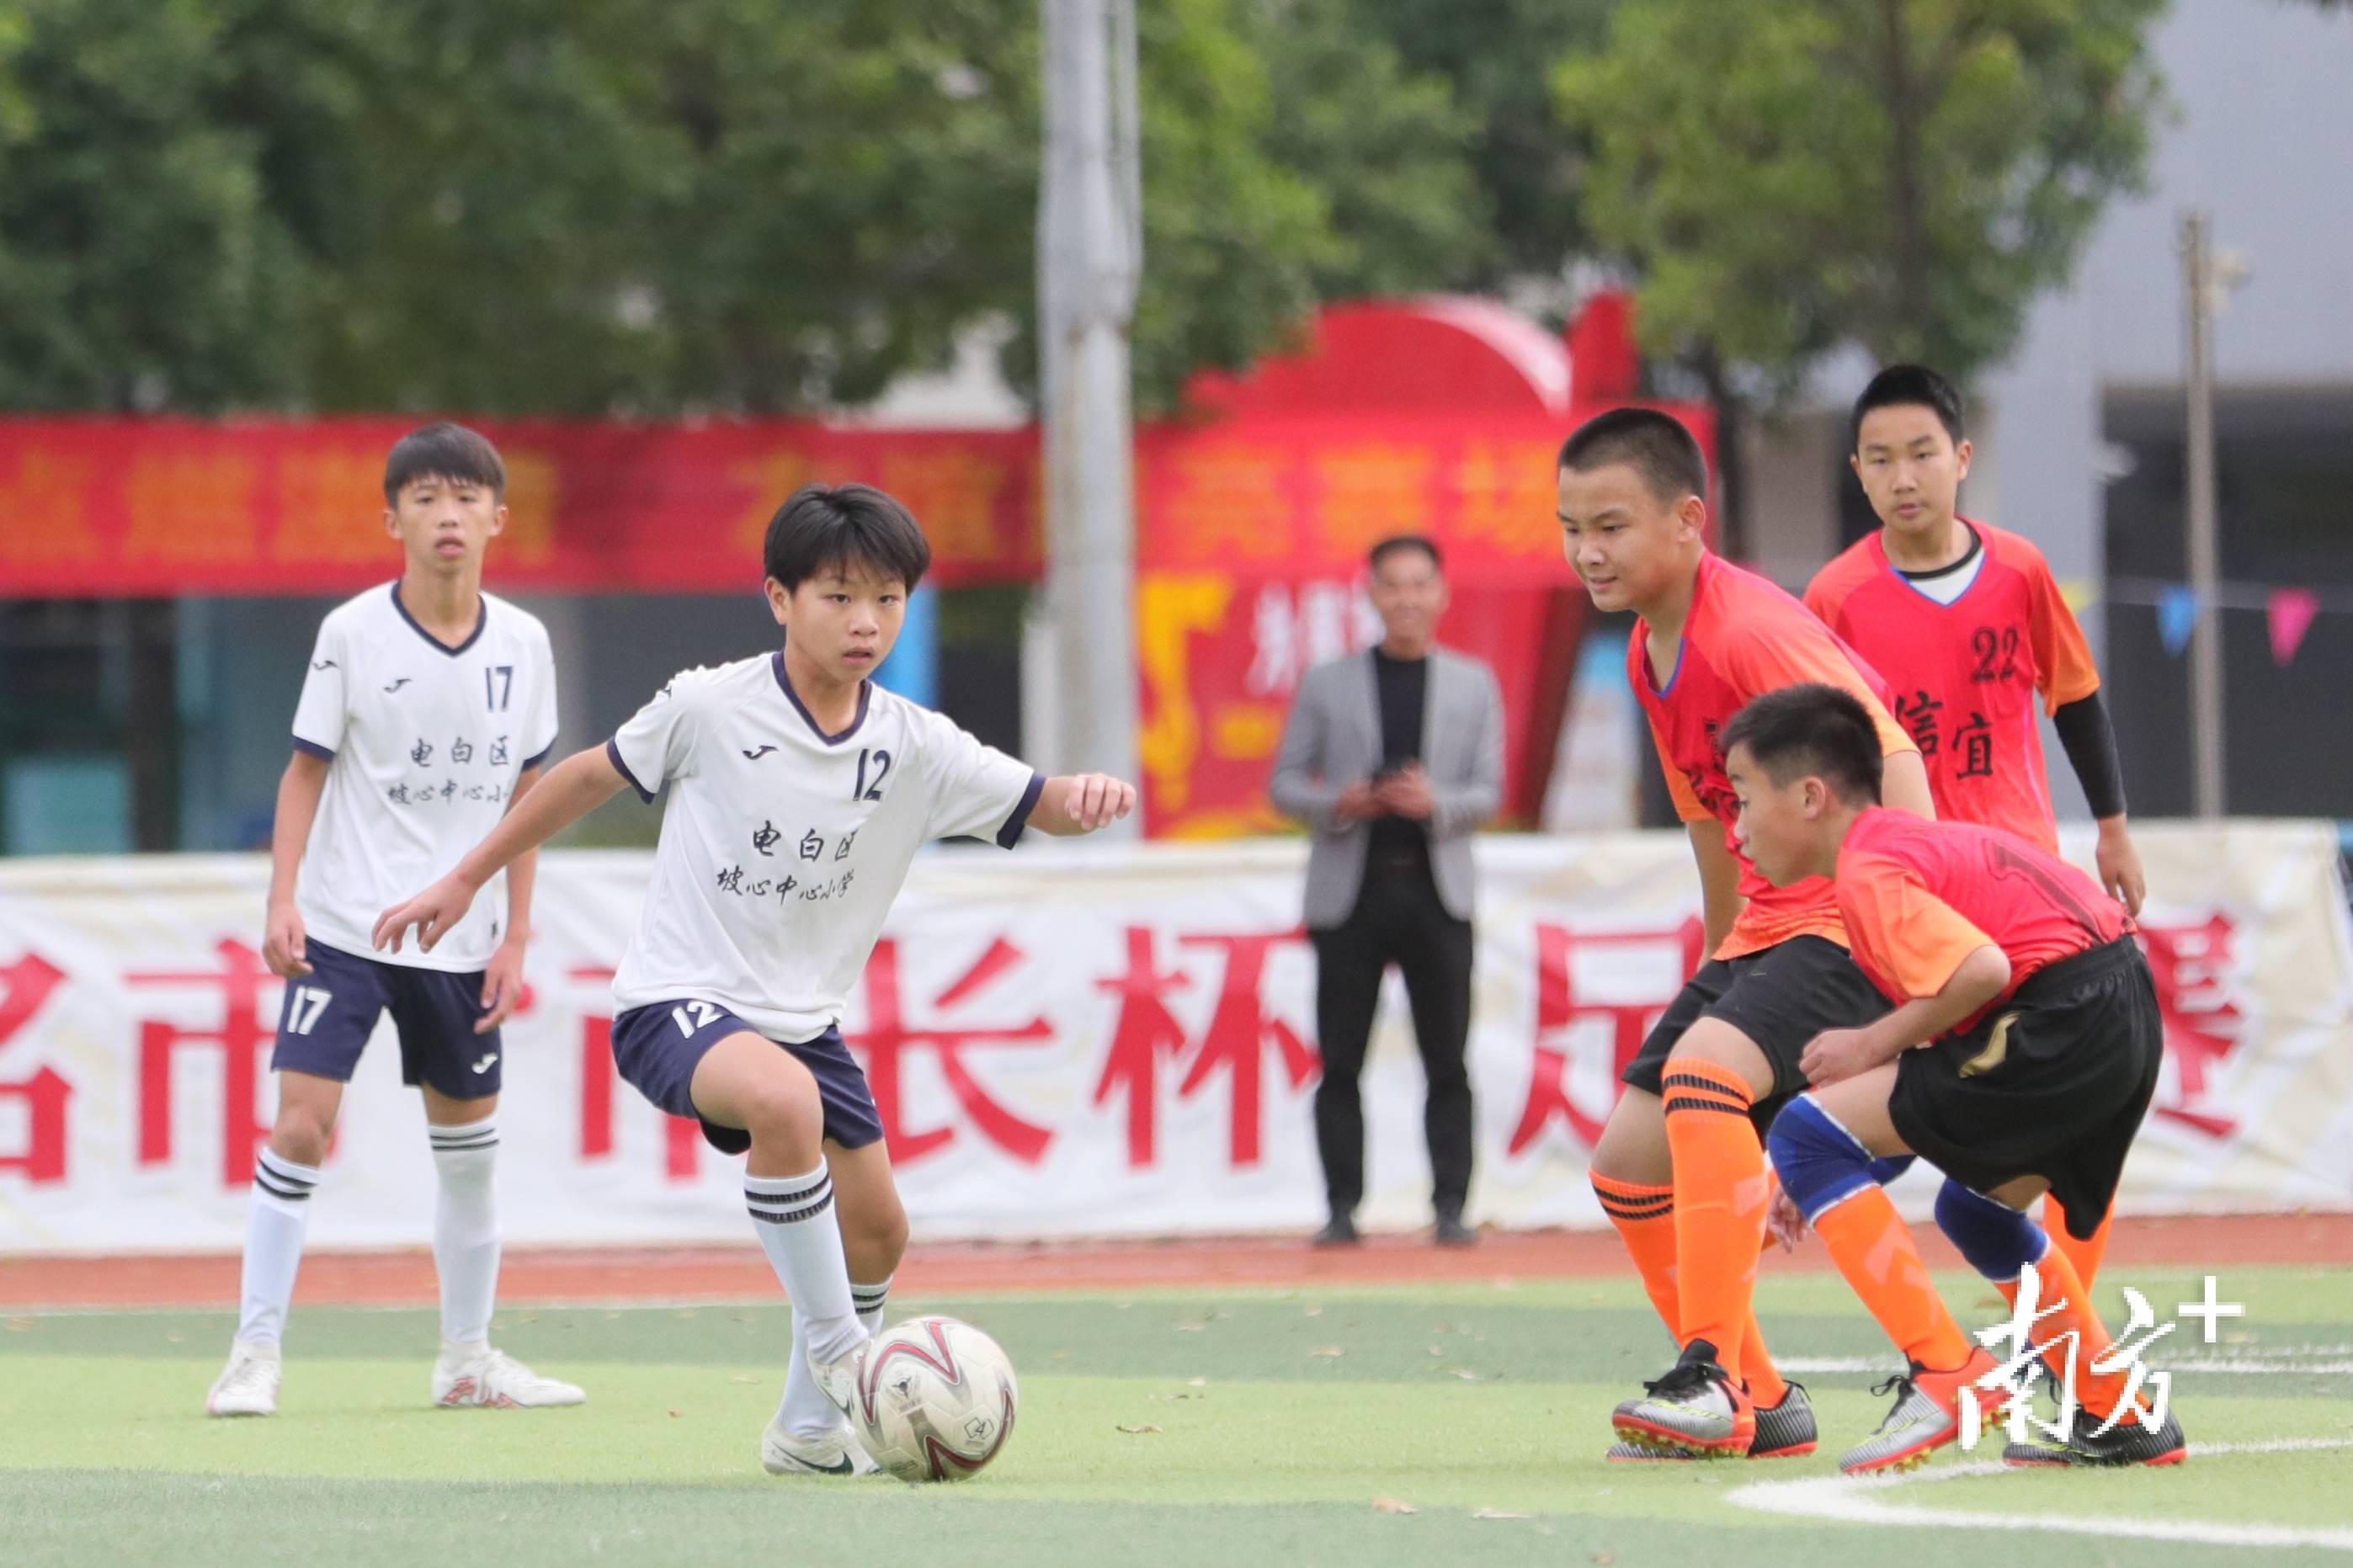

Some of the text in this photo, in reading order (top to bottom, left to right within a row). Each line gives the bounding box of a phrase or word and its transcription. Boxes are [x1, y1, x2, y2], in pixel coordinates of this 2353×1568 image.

[1972, 626, 2019, 685] 22
[485, 666, 514, 713] 17
[410, 736, 509, 767] 电白区
[1895, 690, 1993, 781] 信宜
[852, 748, 892, 802] 12
[753, 820, 859, 862] 电白区
[287, 985, 333, 1035] 17
[672, 999, 724, 1040] 12
